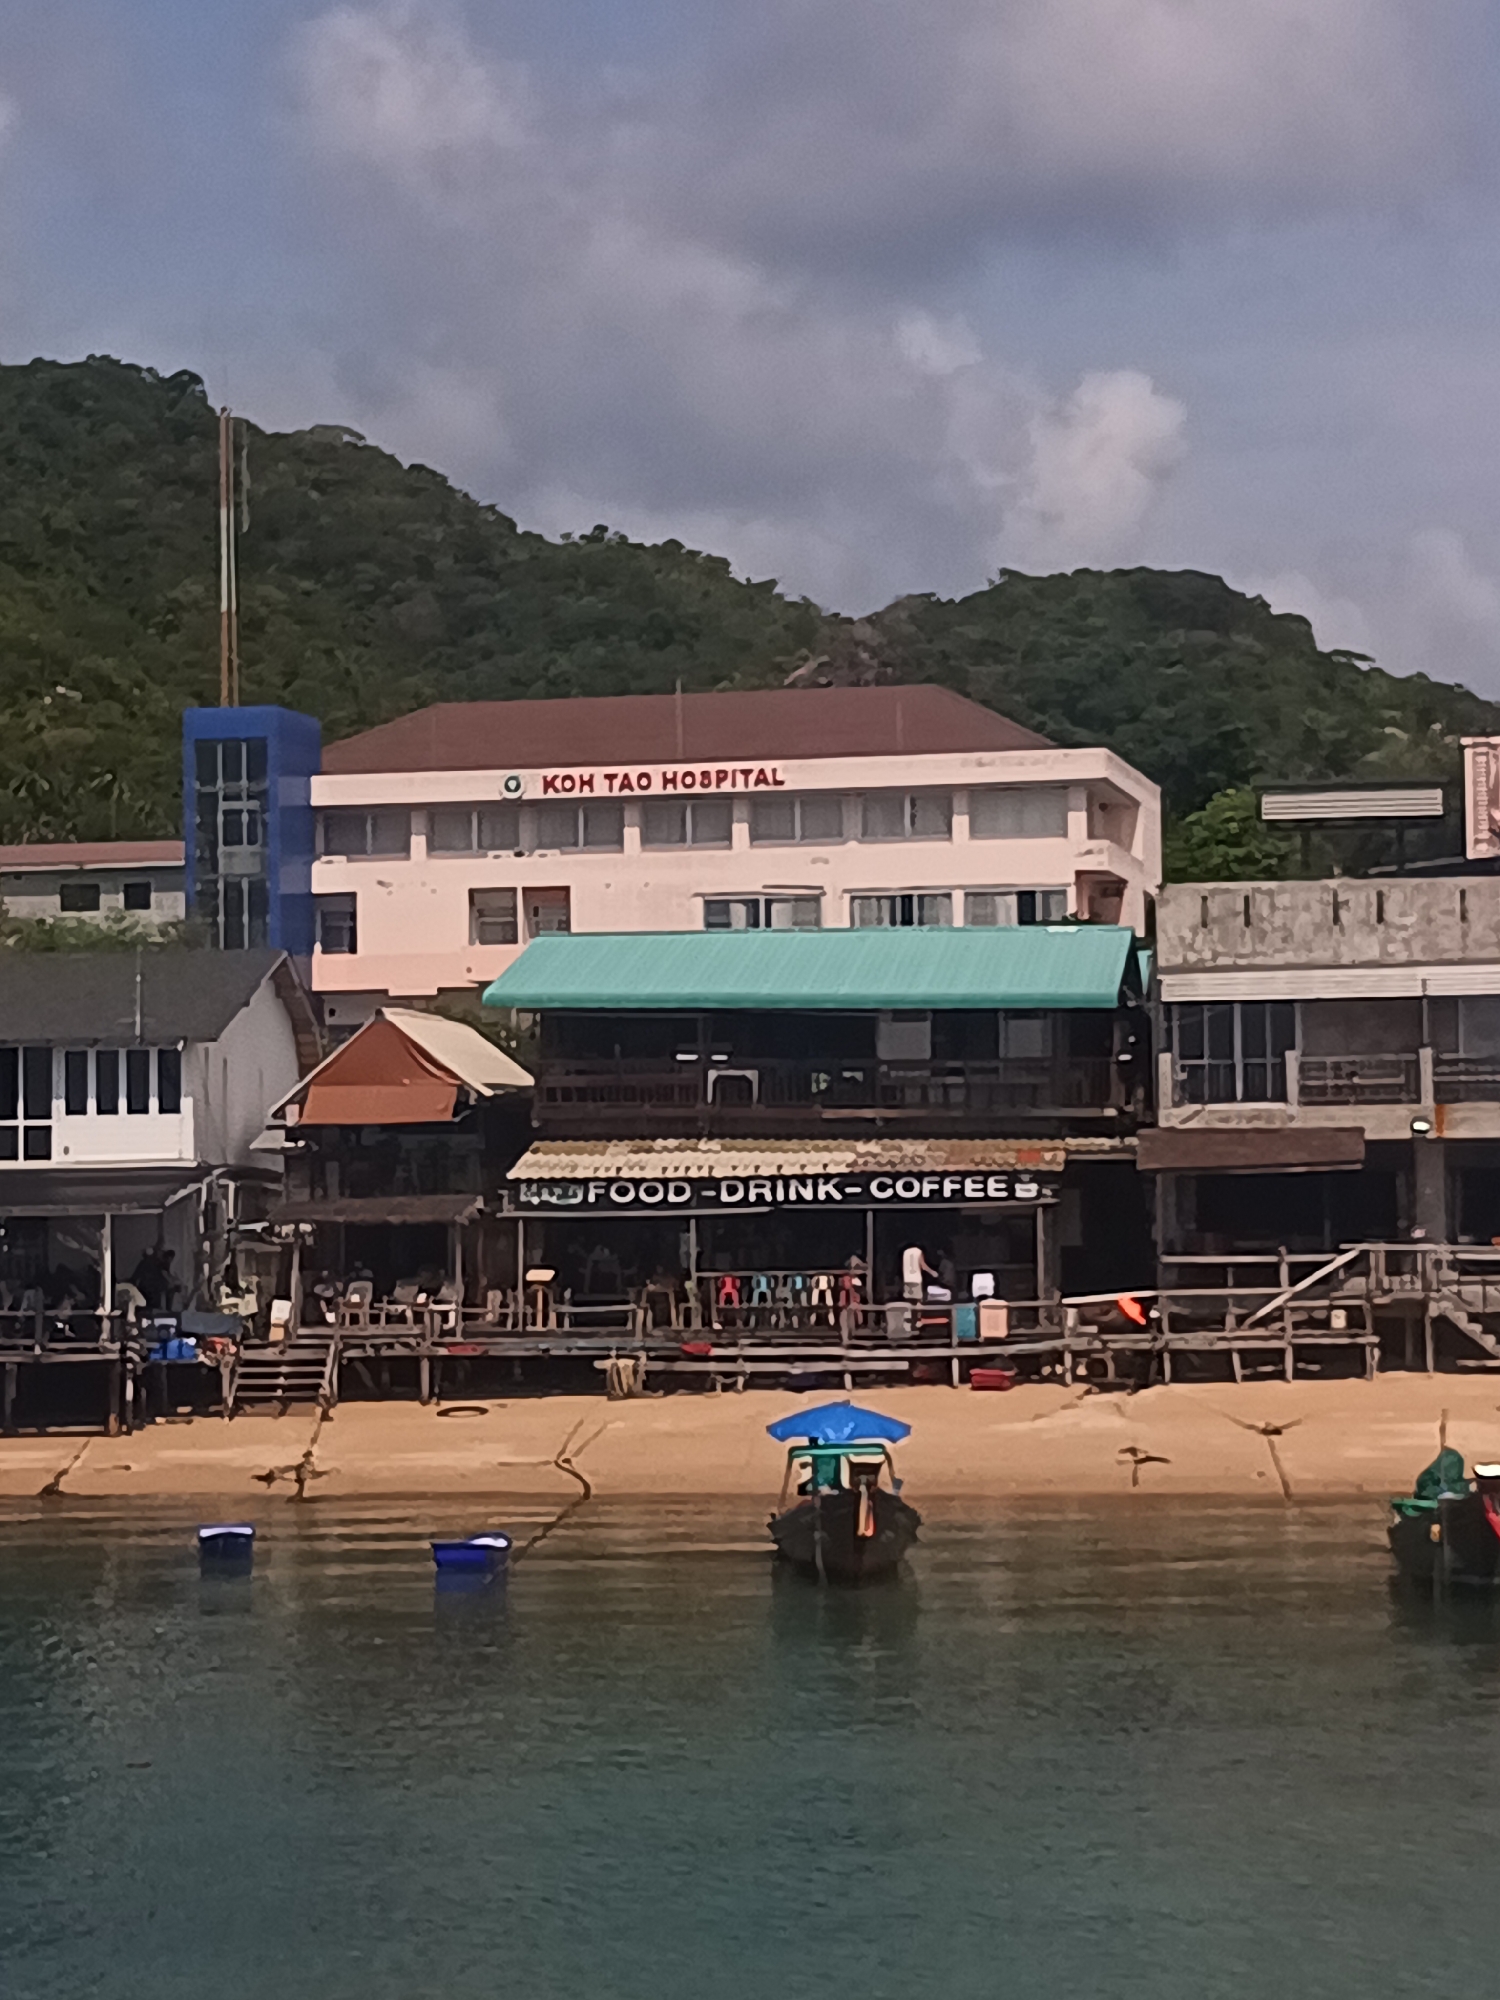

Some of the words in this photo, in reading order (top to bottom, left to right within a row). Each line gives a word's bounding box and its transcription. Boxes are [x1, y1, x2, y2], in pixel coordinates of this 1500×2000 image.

[543, 774, 595, 795] KOH
[604, 772, 652, 793] TAO
[662, 768, 785, 791] HOSPITAL
[588, 1181, 691, 1203] FOOD
[870, 1176, 1009, 1198] COFFEE
